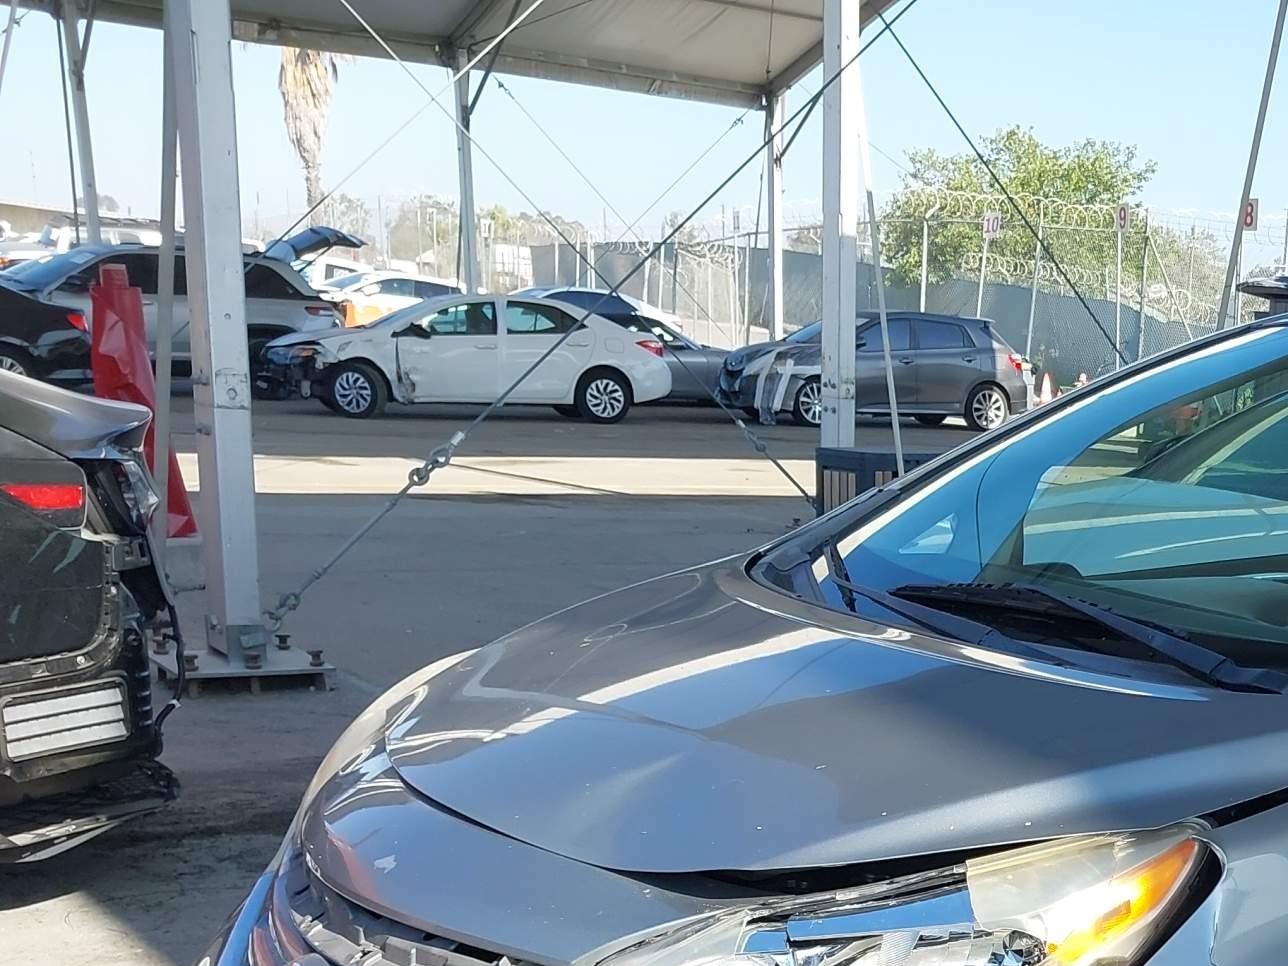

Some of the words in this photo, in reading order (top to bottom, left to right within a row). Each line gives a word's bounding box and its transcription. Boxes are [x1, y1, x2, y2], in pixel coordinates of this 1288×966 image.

[984, 216, 999, 233] 10
[1118, 206, 1127, 229] 9
[1244, 202, 1254, 227] 8
